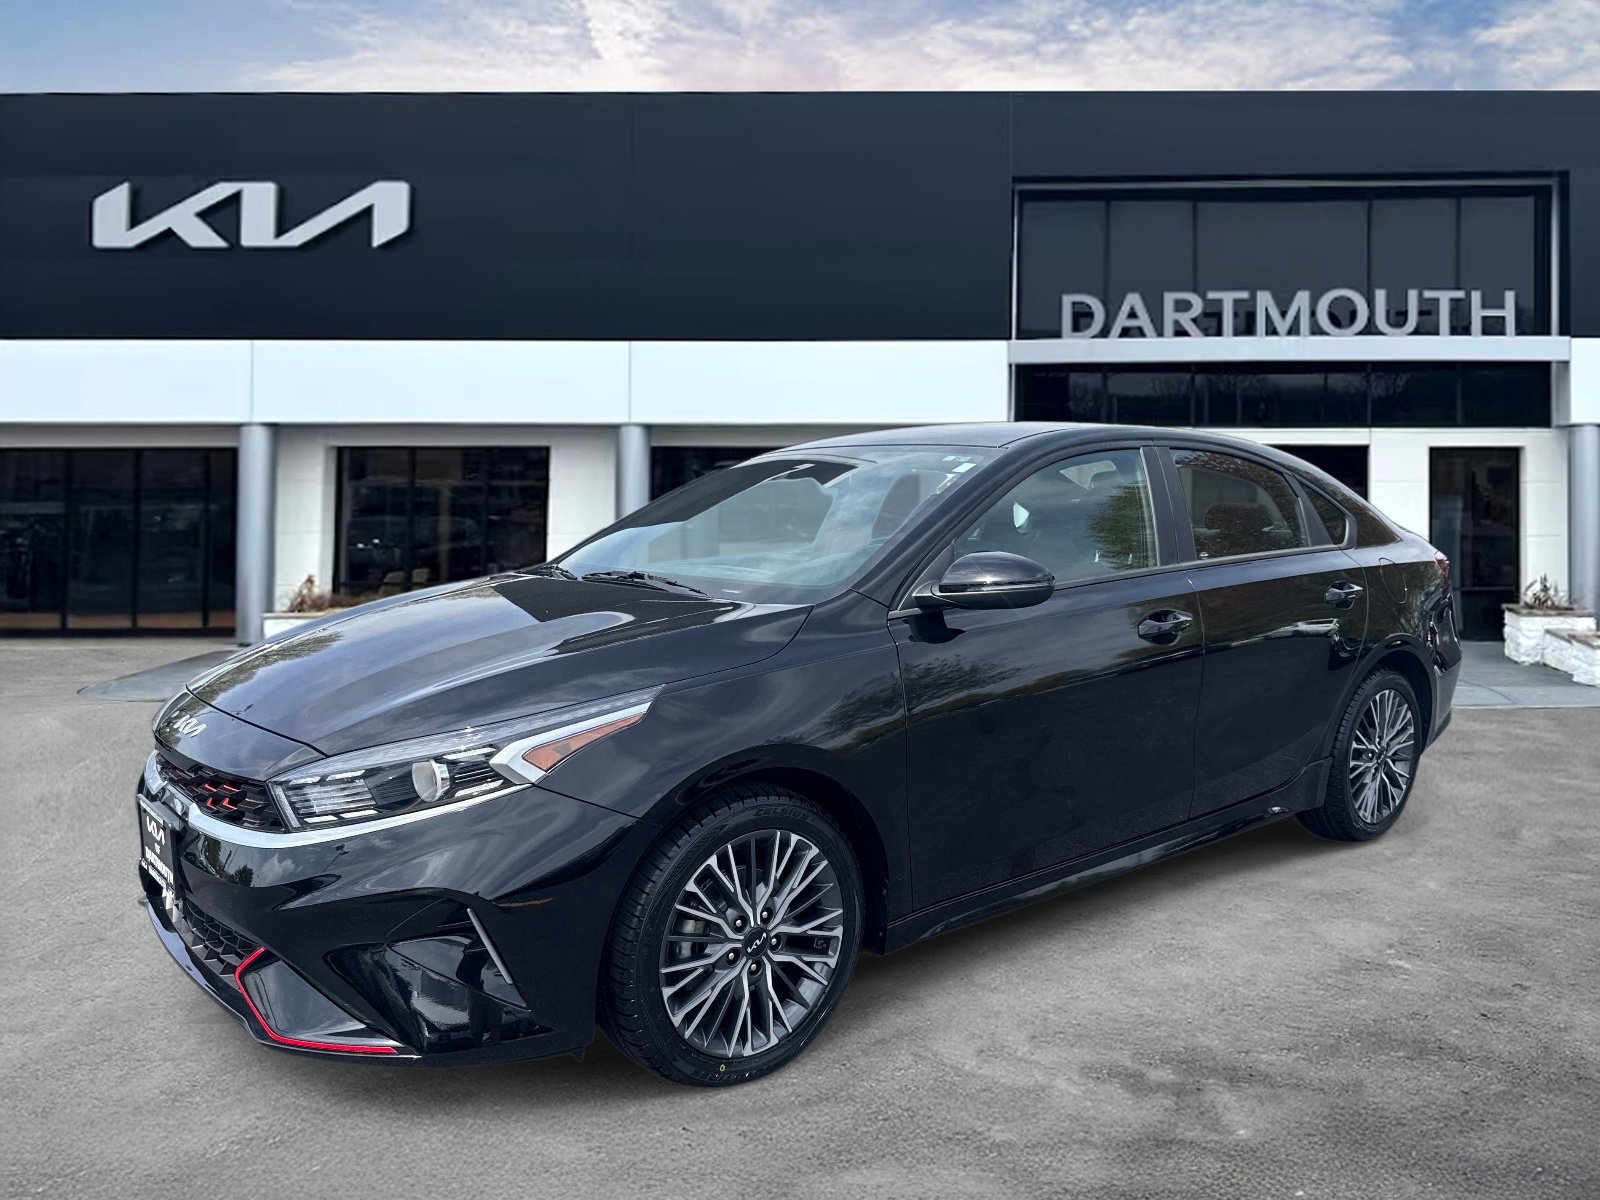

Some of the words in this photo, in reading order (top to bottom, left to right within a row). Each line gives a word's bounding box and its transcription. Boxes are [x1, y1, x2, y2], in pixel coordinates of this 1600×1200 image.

[92, 180, 411, 249] KIA
[1060, 288, 1517, 339] DARTMOUTH
[746, 931, 767, 953] KIA
